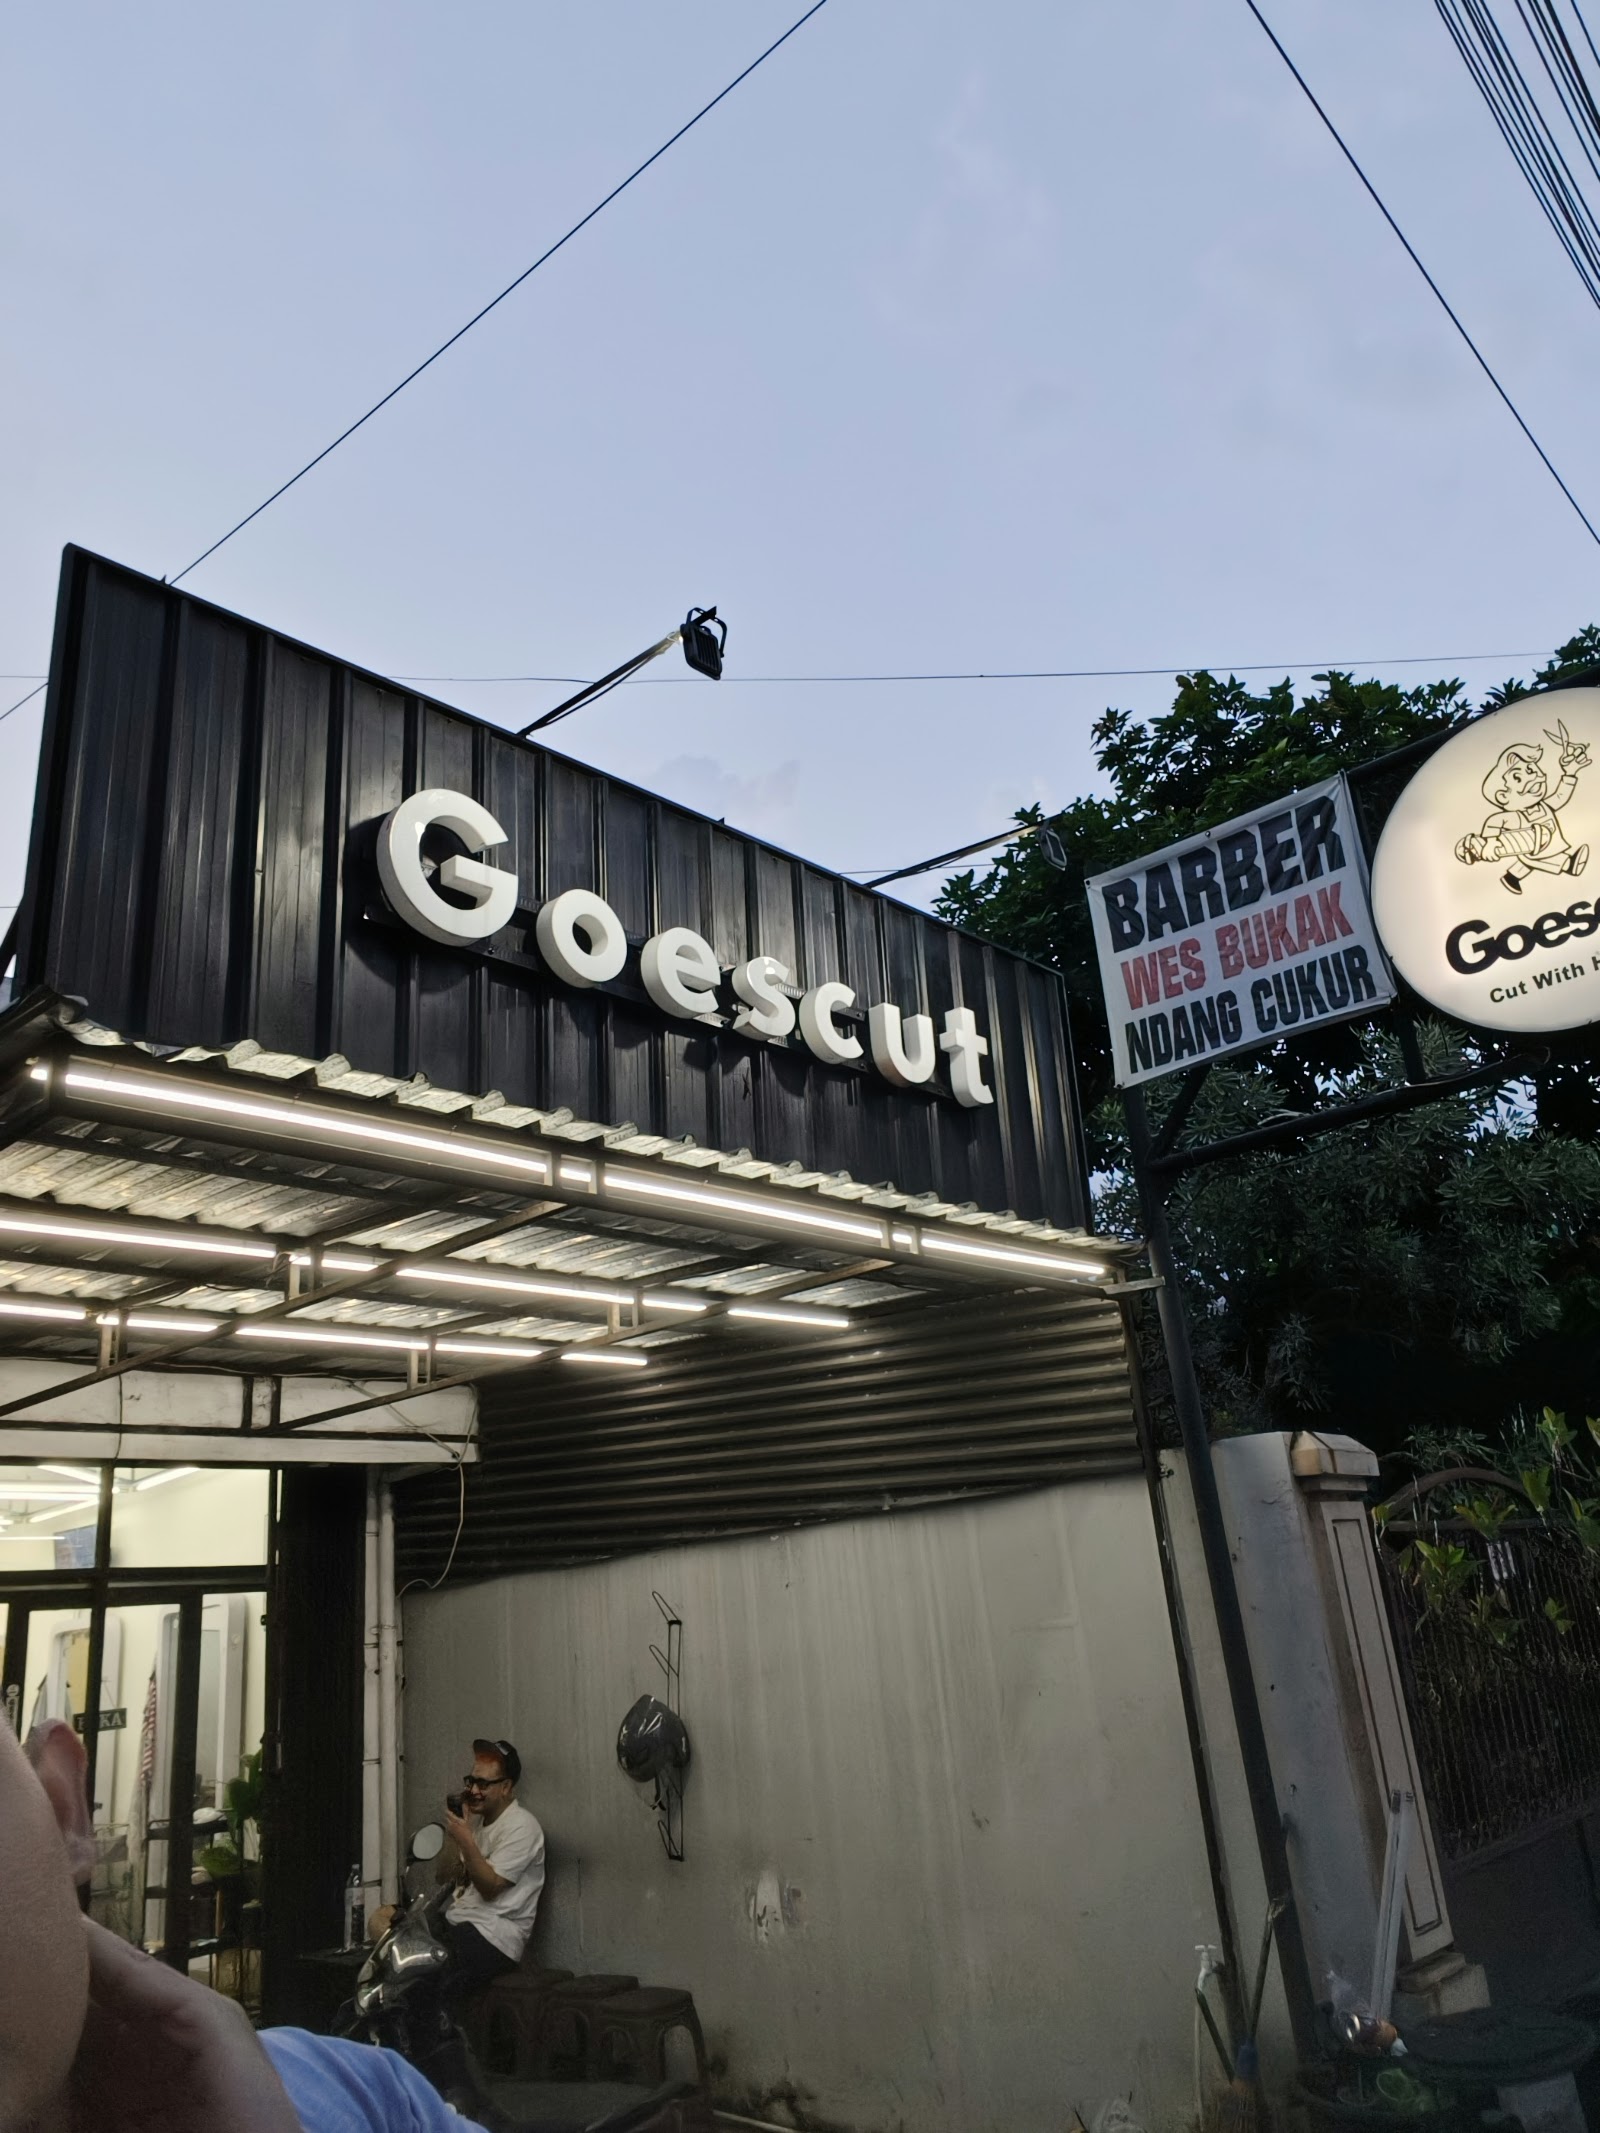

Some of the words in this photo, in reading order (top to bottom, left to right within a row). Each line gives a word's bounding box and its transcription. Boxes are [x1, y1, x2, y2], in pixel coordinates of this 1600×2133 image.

[1101, 795, 1346, 953] BARBER
[1445, 897, 1600, 975] Goes
[376, 788, 994, 1108] Goescut
[1120, 937, 1206, 1010] WES
[1215, 881, 1354, 980] BUKAK
[1125, 989, 1243, 1074] NDANG
[1251, 944, 1377, 1033] CUKUR
[1490, 981, 1528, 1003] Cut
[1532, 963, 1585, 989] With
